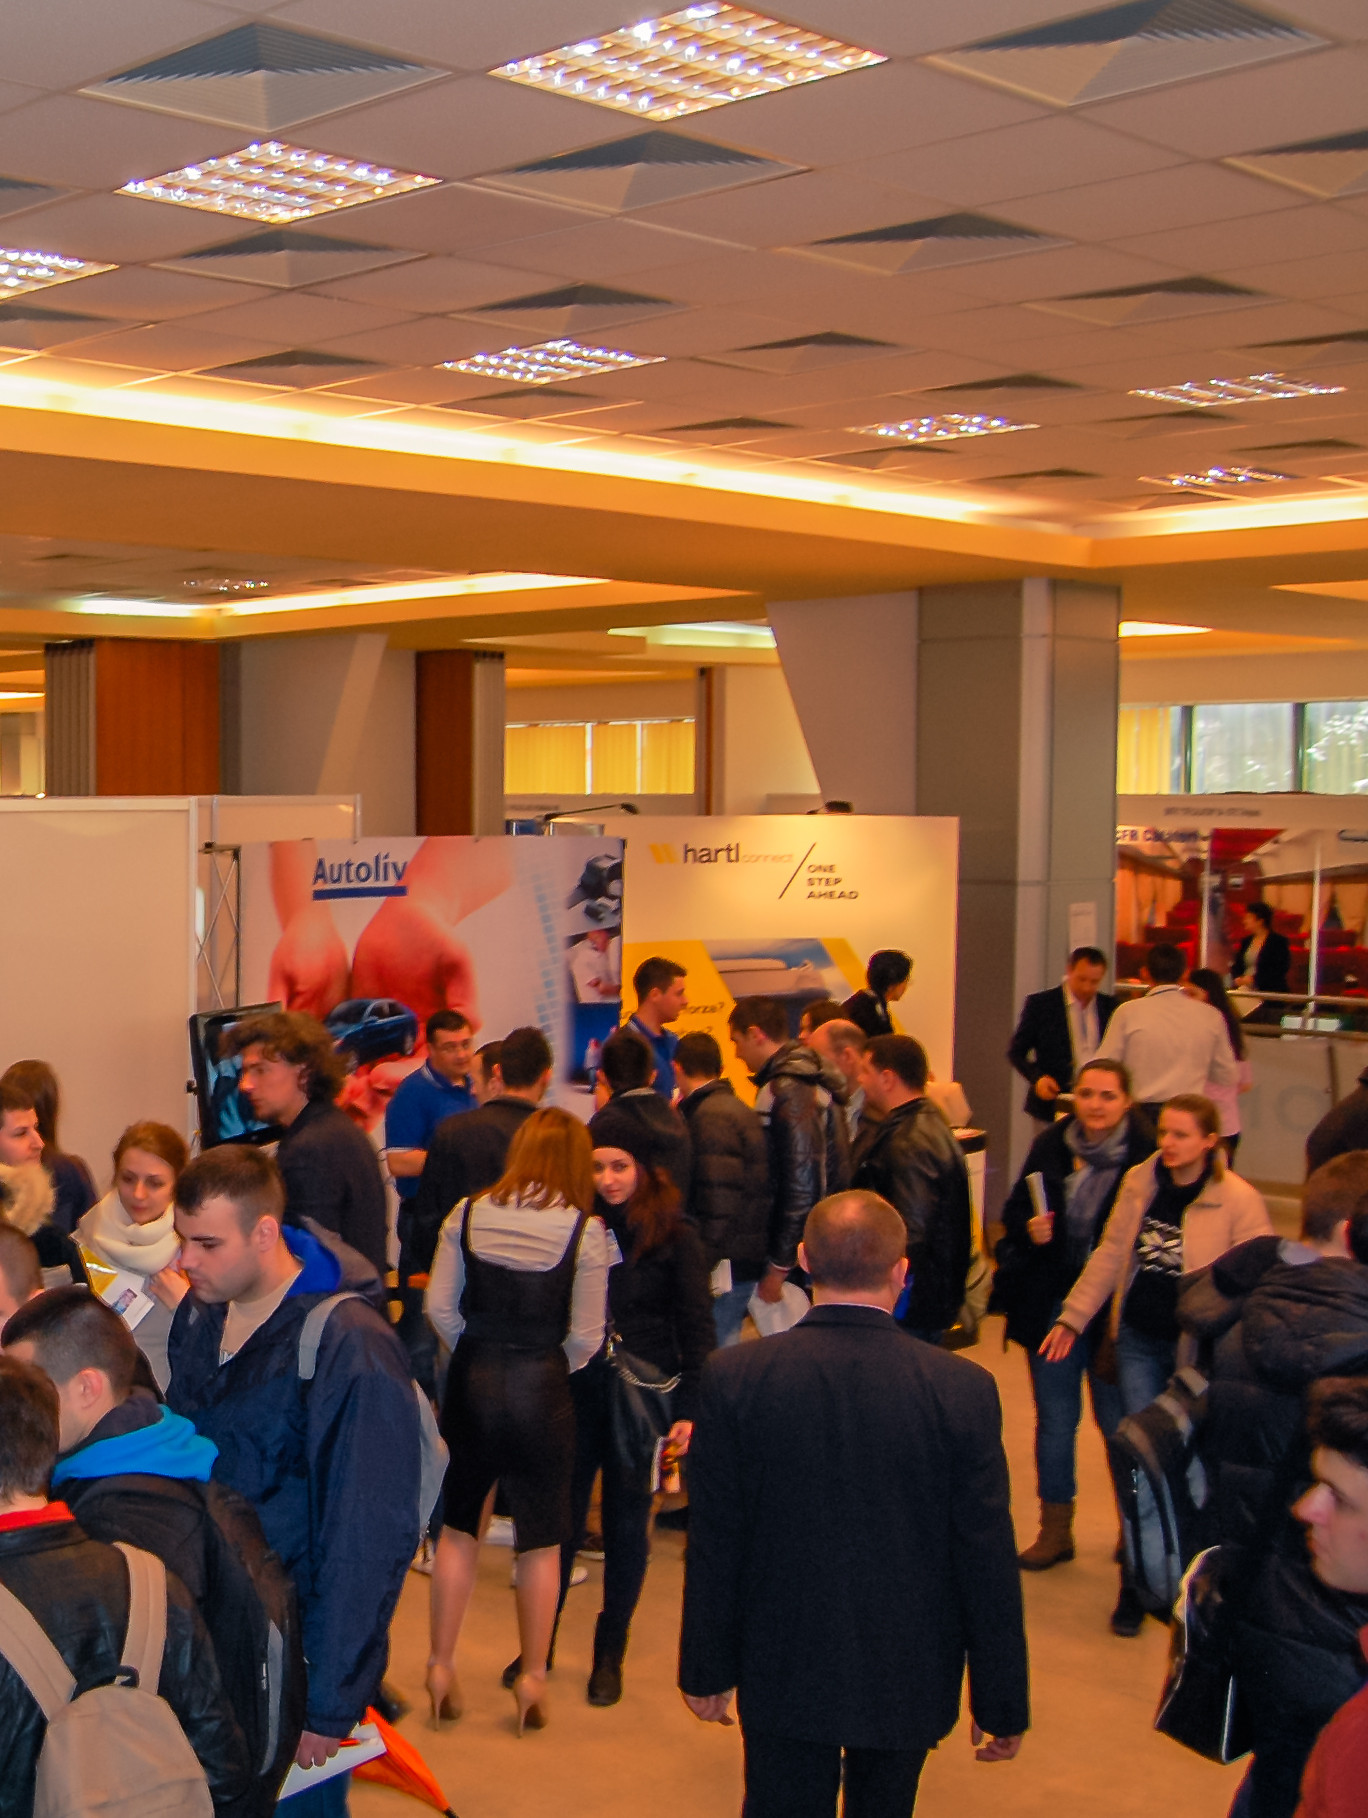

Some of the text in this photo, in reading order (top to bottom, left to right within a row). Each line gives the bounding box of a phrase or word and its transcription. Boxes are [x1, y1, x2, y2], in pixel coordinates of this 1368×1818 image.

[683, 842, 740, 863] hartl
[312, 851, 408, 885] Autoliv
[807, 864, 836, 873] ONE
[807, 877, 843, 887] STEP
[807, 890, 860, 900] AHEAD
